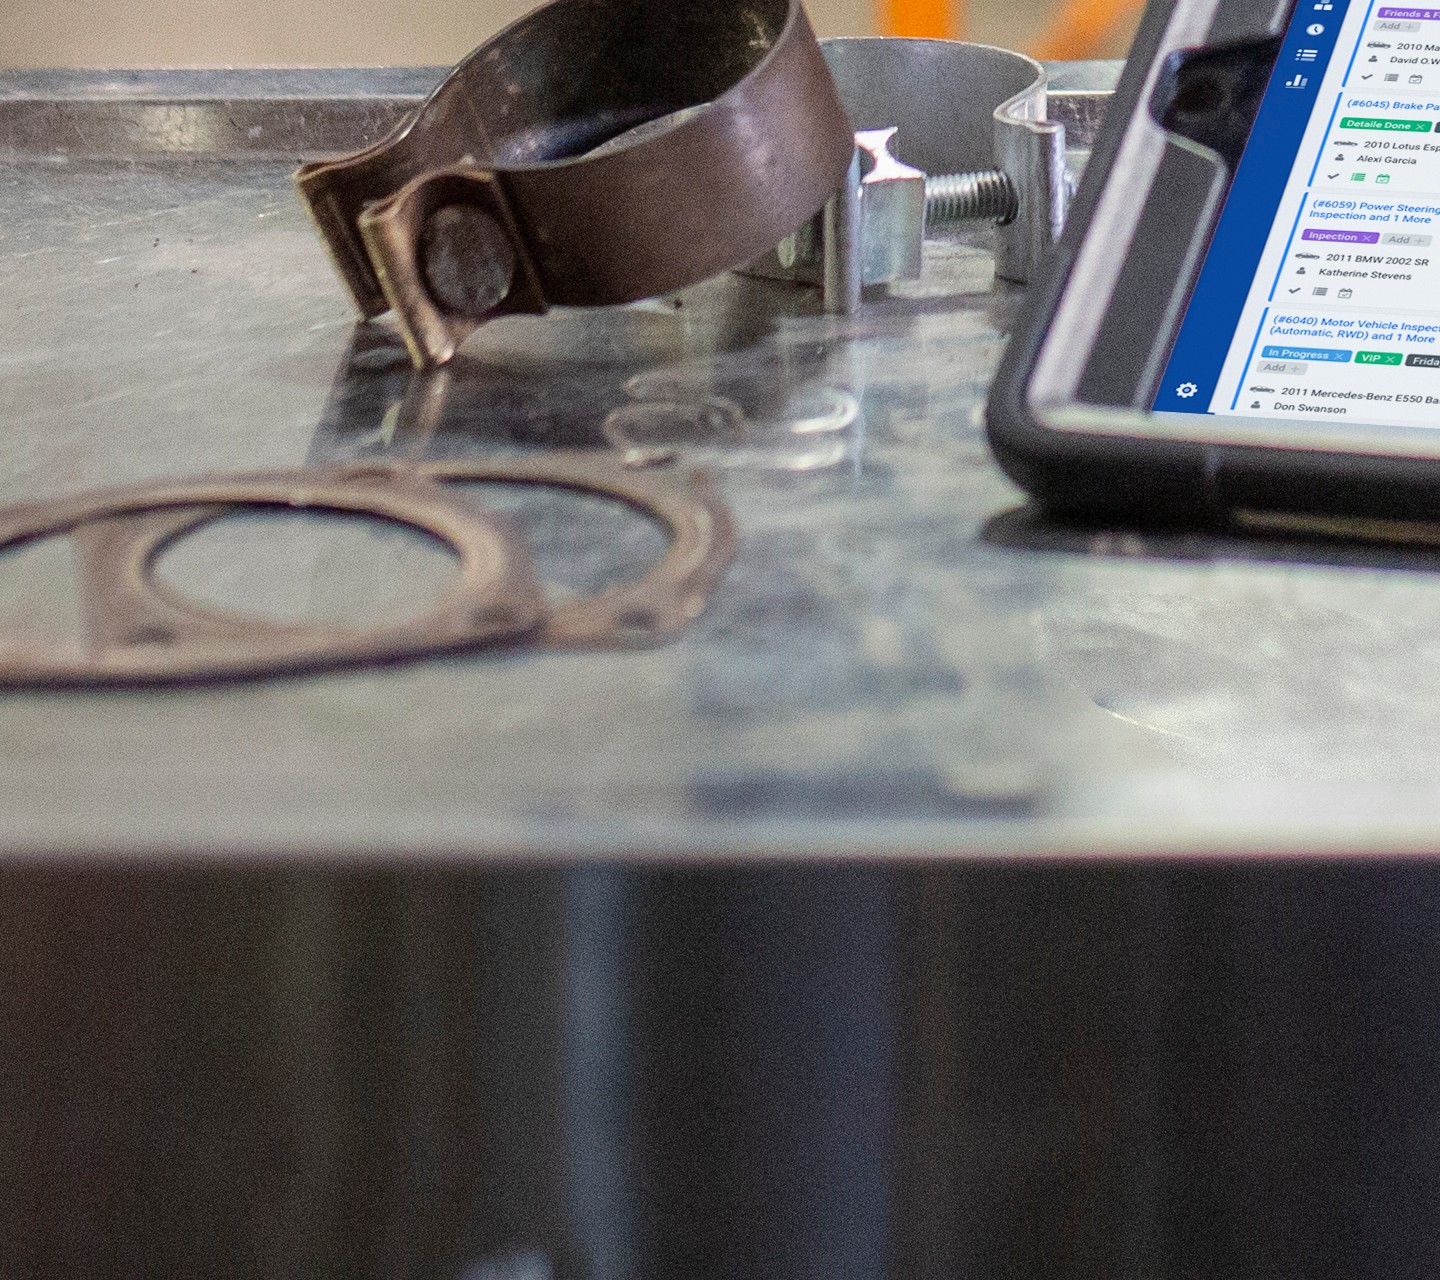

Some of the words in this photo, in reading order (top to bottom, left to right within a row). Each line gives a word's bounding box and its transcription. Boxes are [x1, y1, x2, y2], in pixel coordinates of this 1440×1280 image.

[1383, 9, 1423, 18] Friends
[1422, 9, 1431, 18] &
[1389, 56, 1419, 64] David
[1346, 98, 1390, 110] (#6045)
[1392, 100, 1424, 110] Brake
[1346, 118, 1383, 130] Detaile
[1383, 120, 1412, 131] Done
[1356, 154, 1382, 163] Alexi
[1383, 155, 1417, 165] Garcia
[1312, 199, 1357, 211] (#6059)
[1358, 201, 1395, 211] Power
[1307, 230, 1358, 243] Inpection
[1318, 268, 1369, 278] Katherine
[1370, 270, 1412, 281] Stevens
[1272, 314, 1318, 327] (#6040)
[1320, 317, 1355, 328] Motor
[1357, 319, 1399, 330] Vehicle
[1361, 353, 1382, 364] VIP
[1273, 401, 1296, 411] Don
[1297, 402, 1347, 414] Swanson
